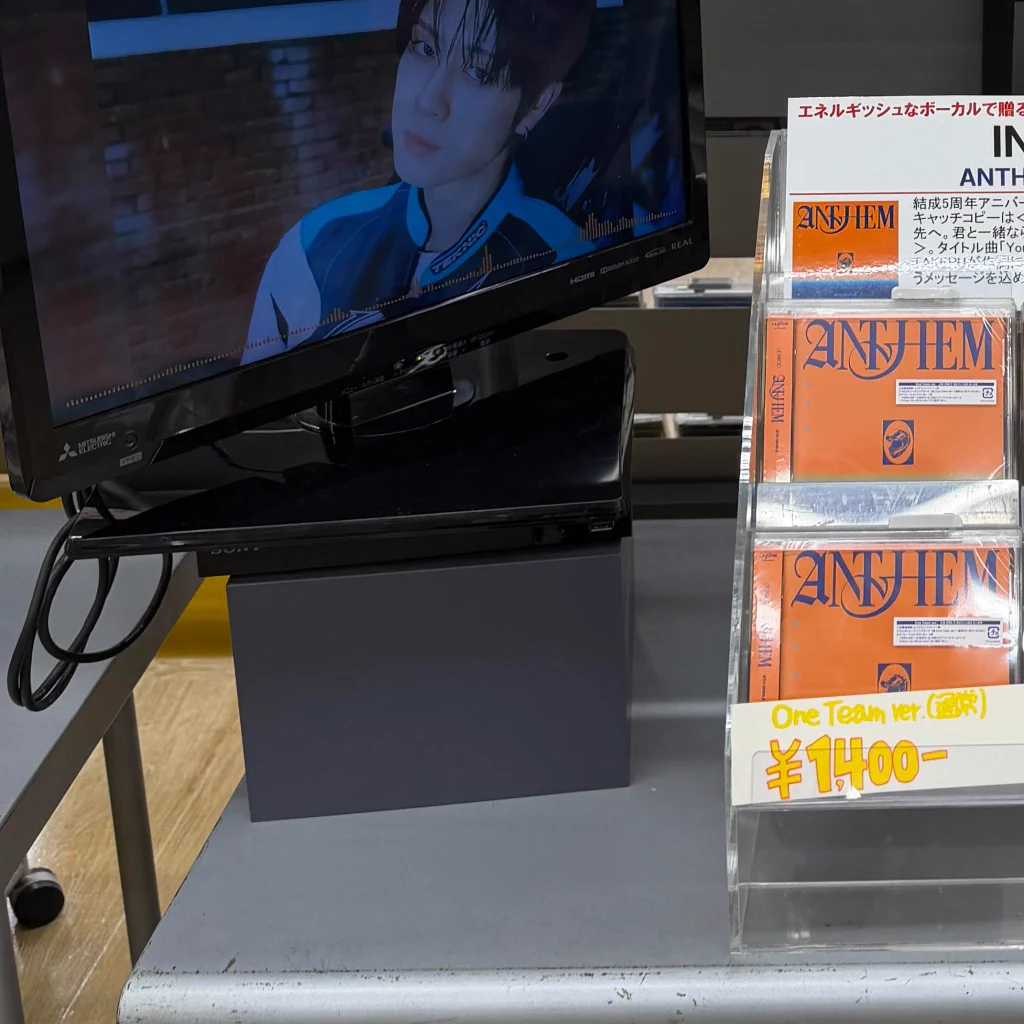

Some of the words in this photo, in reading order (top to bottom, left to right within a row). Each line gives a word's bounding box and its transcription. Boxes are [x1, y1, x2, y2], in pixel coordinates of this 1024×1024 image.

[797, 205, 895, 234] ANTHEM
[671, 239, 694, 250] REAL
[570, 271, 595, 285] HDMI
[803, 319, 996, 380] ANTHEM
[791, 548, 1007, 618] ANTHEM
[772, 704, 820, 729] One
[823, 700, 886, 726] Team
